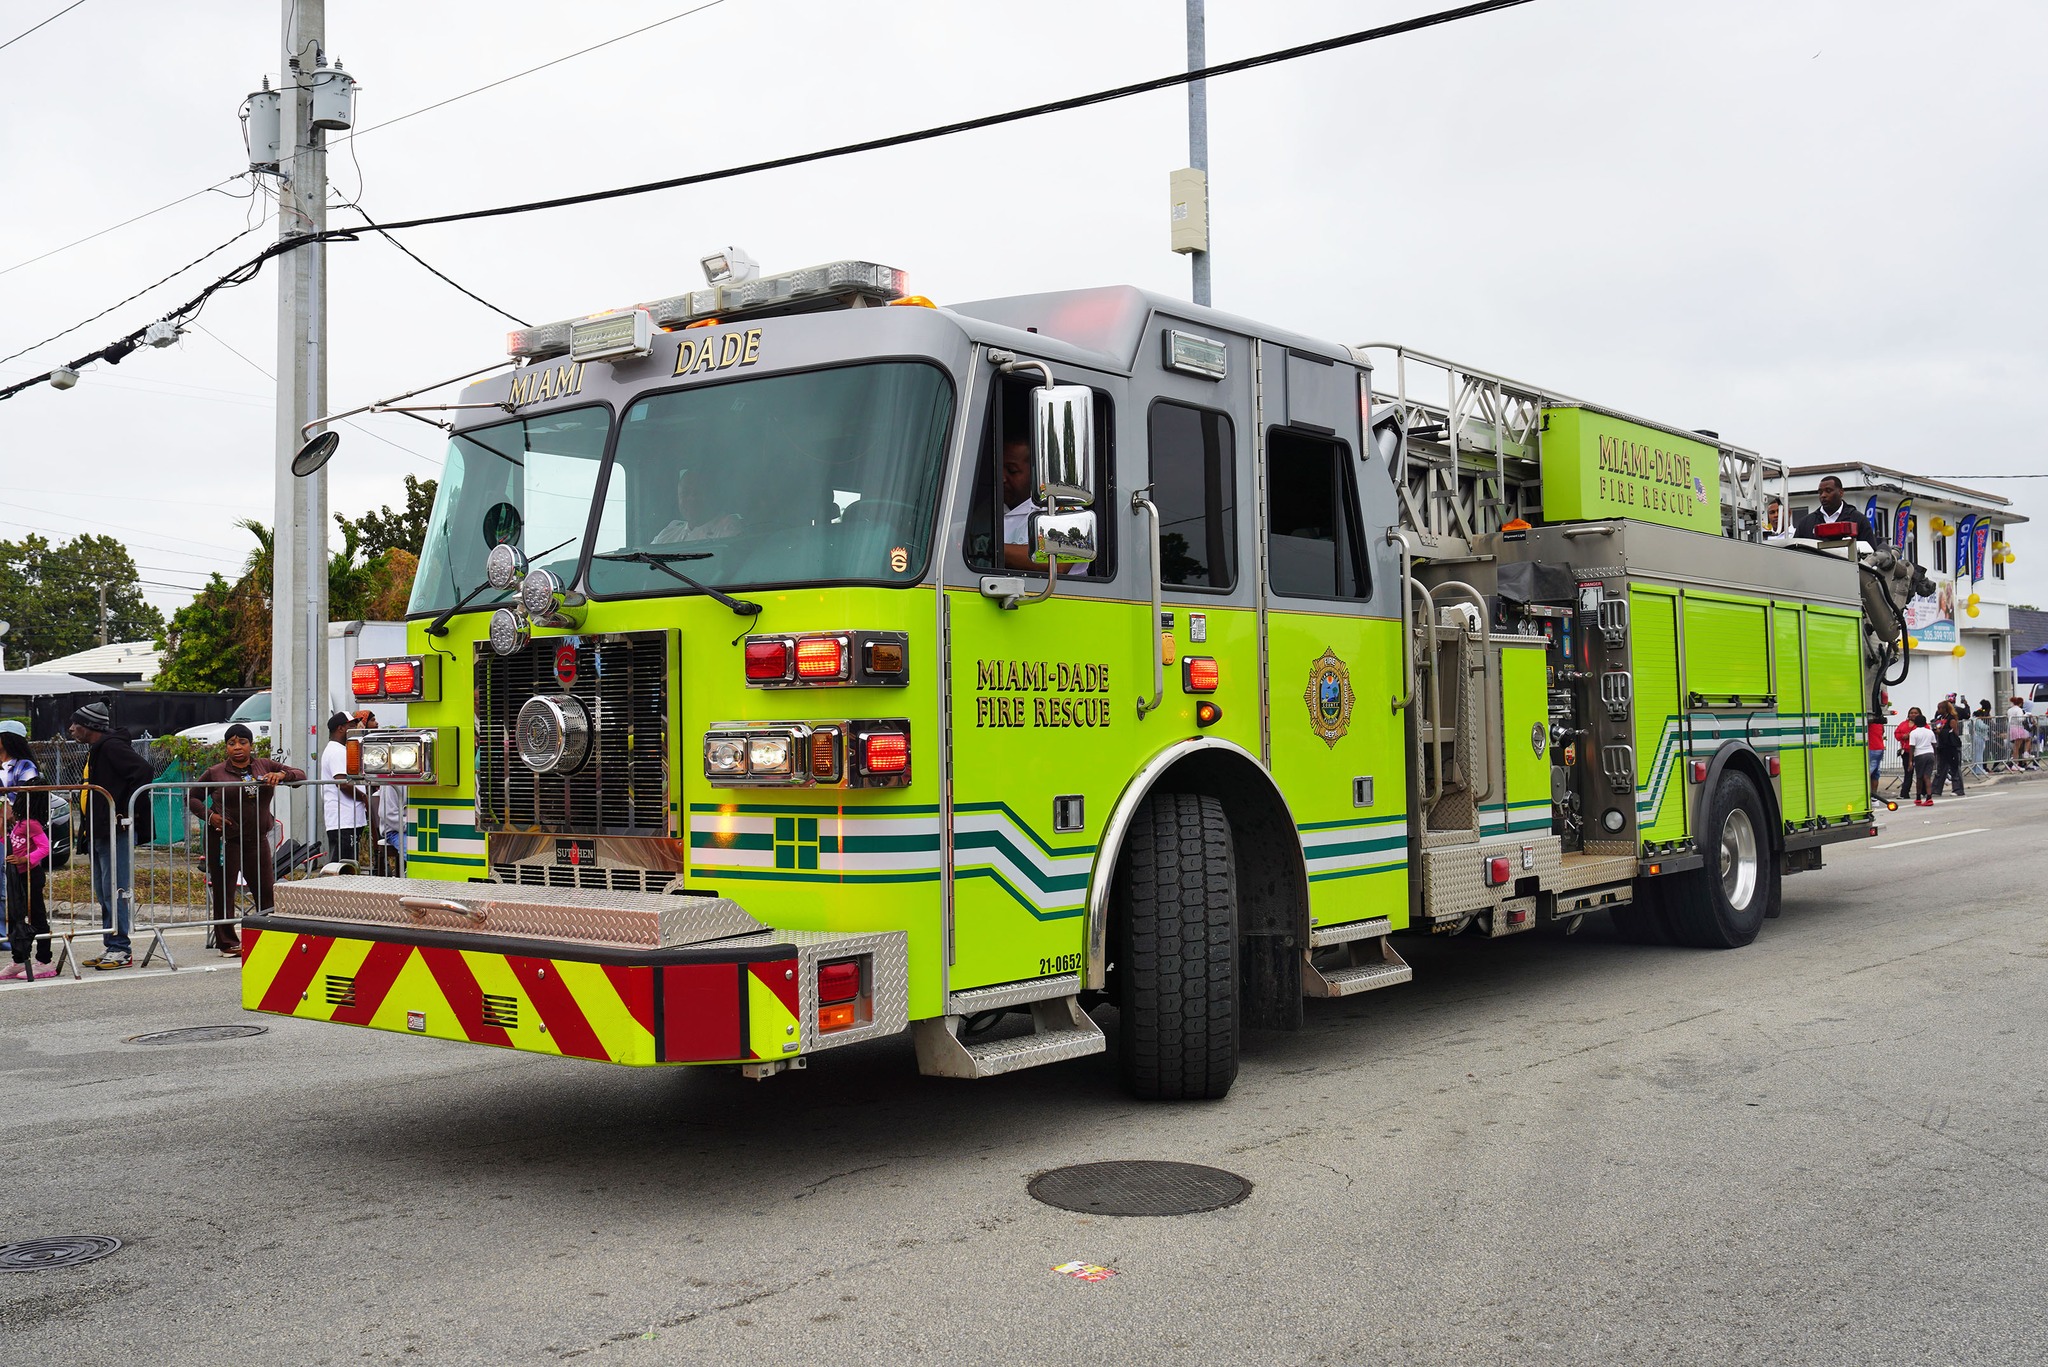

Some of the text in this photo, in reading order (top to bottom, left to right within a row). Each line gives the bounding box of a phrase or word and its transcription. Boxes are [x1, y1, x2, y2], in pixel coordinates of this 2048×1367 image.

[671, 328, 762, 378] DADE
[508, 362, 586, 407] MIAMI
[1599, 434, 1691, 489] MIAMI-DADE
[1600, 476, 1692, 516] FIRE RESCUE
[976, 659, 1110, 692] MIAMI-DADE
[1324, 657, 1336, 666] FIRE
[976, 697, 1110, 727] FIRE RESCUE
[1820, 712, 1855, 748] MDFR
[556, 847, 594, 859] SUTPHEN
[1040, 952, 1082, 975] 21-0652
